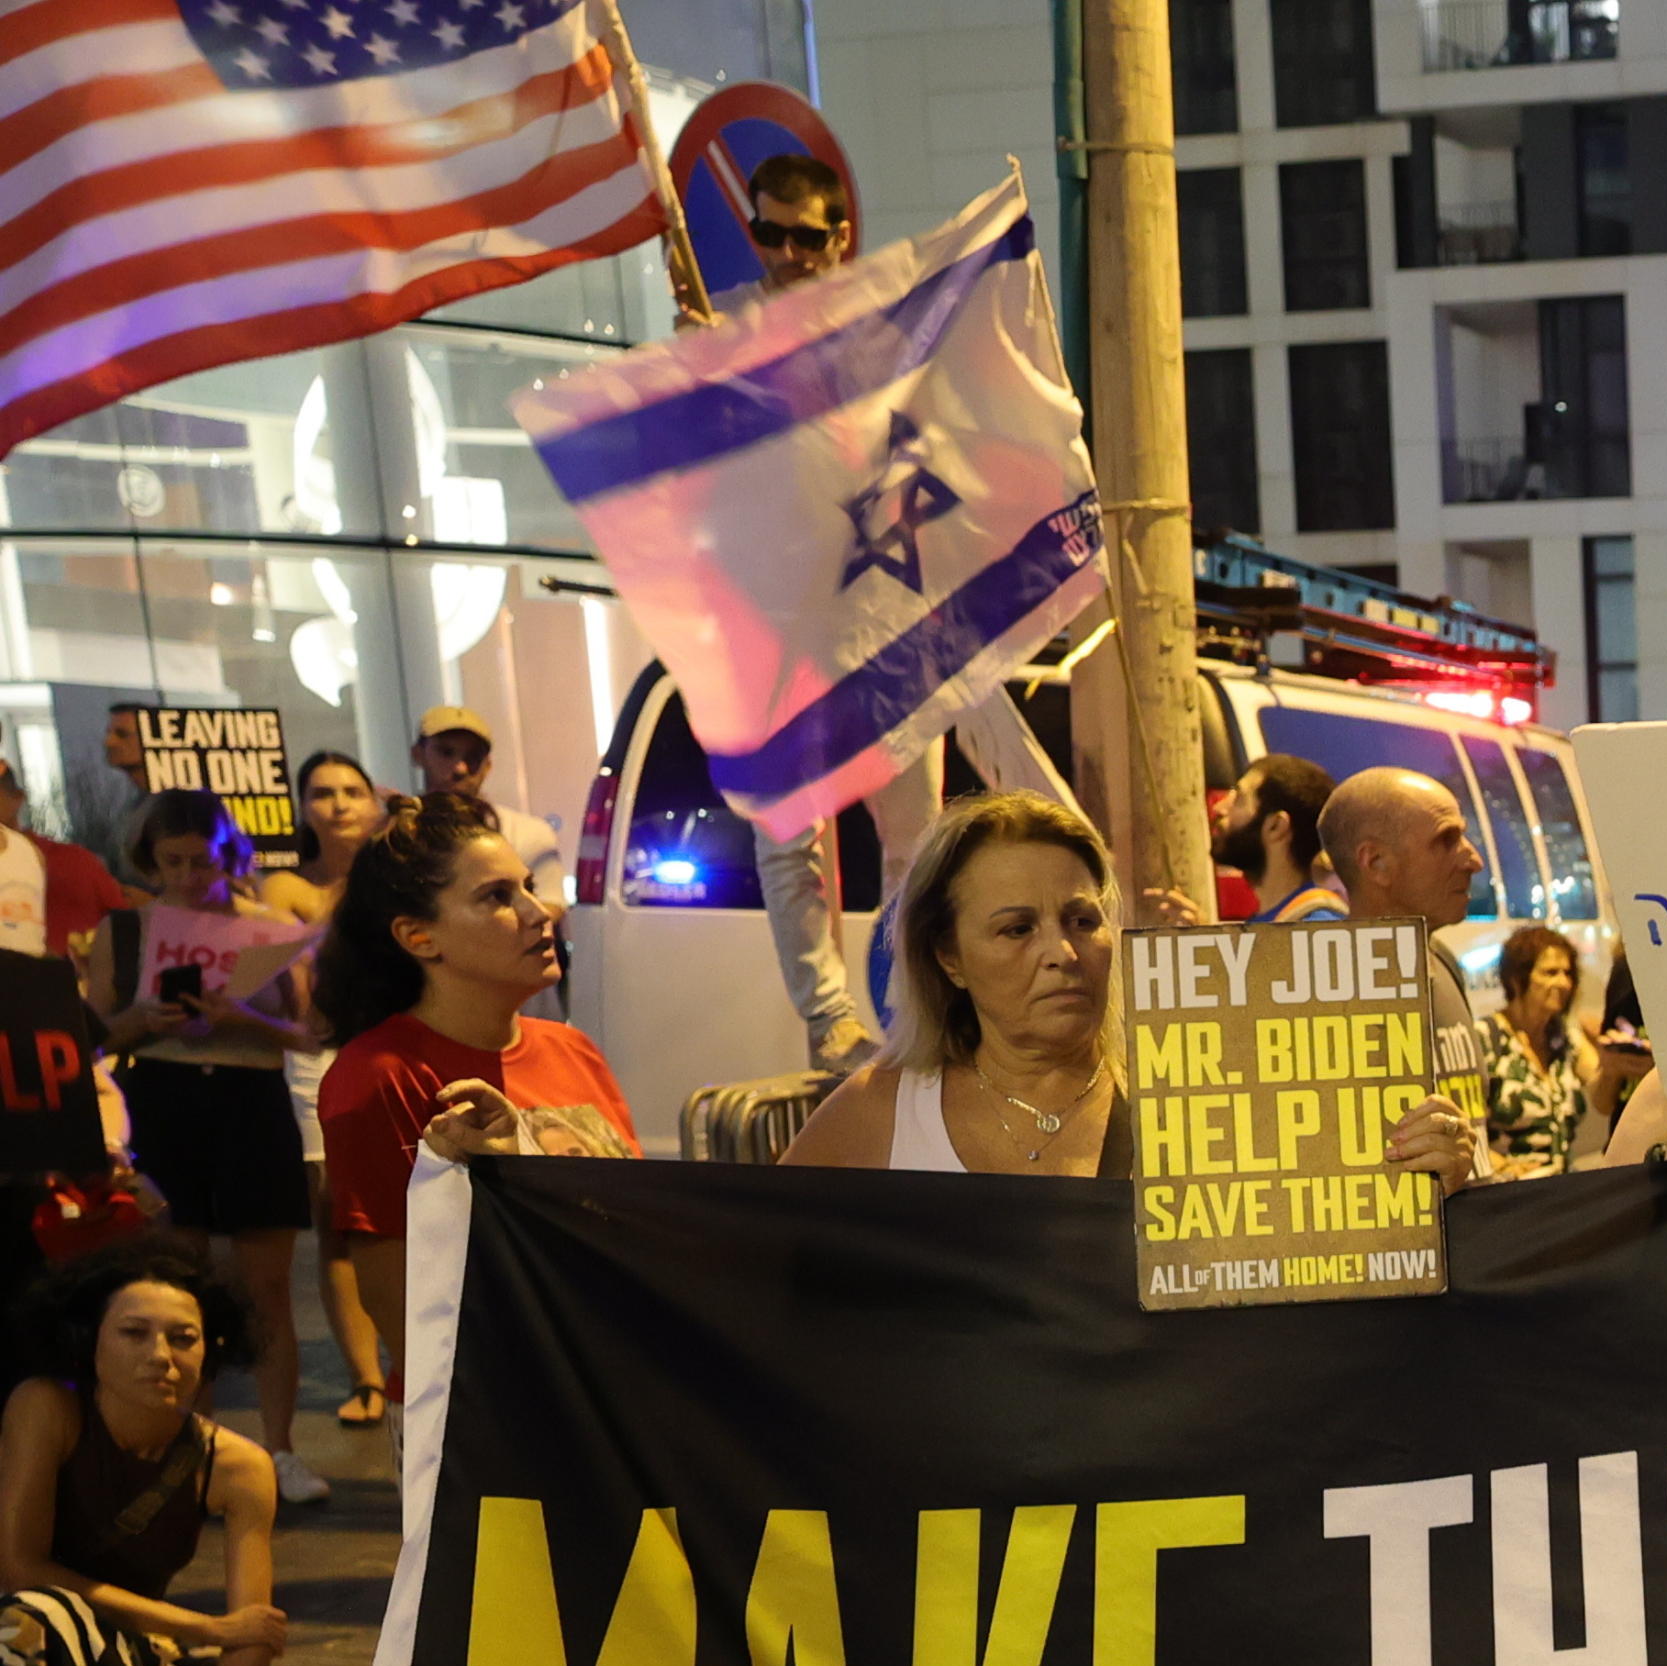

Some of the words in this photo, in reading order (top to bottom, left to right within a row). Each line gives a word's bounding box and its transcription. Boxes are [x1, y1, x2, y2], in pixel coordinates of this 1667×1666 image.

[137, 709, 281, 749] LEAVING
[144, 750, 203, 794] NO
[205, 750, 288, 794] ONE
[1132, 932, 1256, 1011] HEY
[1271, 926, 1418, 1004] JOE!
[1136, 1021, 1243, 1089] MR.
[1255, 1012, 1424, 1083] BIDEN
[1139, 1089, 1321, 1178] HELP
[1144, 1179, 1274, 1242] SAVE
[1282, 1172, 1433, 1234] THEM!
[1150, 1260, 1198, 1295] ALL
[1195, 1269, 1210, 1284] OF
[1210, 1258, 1280, 1290] THEM
[1283, 1254, 1365, 1286] HOME!
[1368, 1249, 1437, 1282] NOW!
